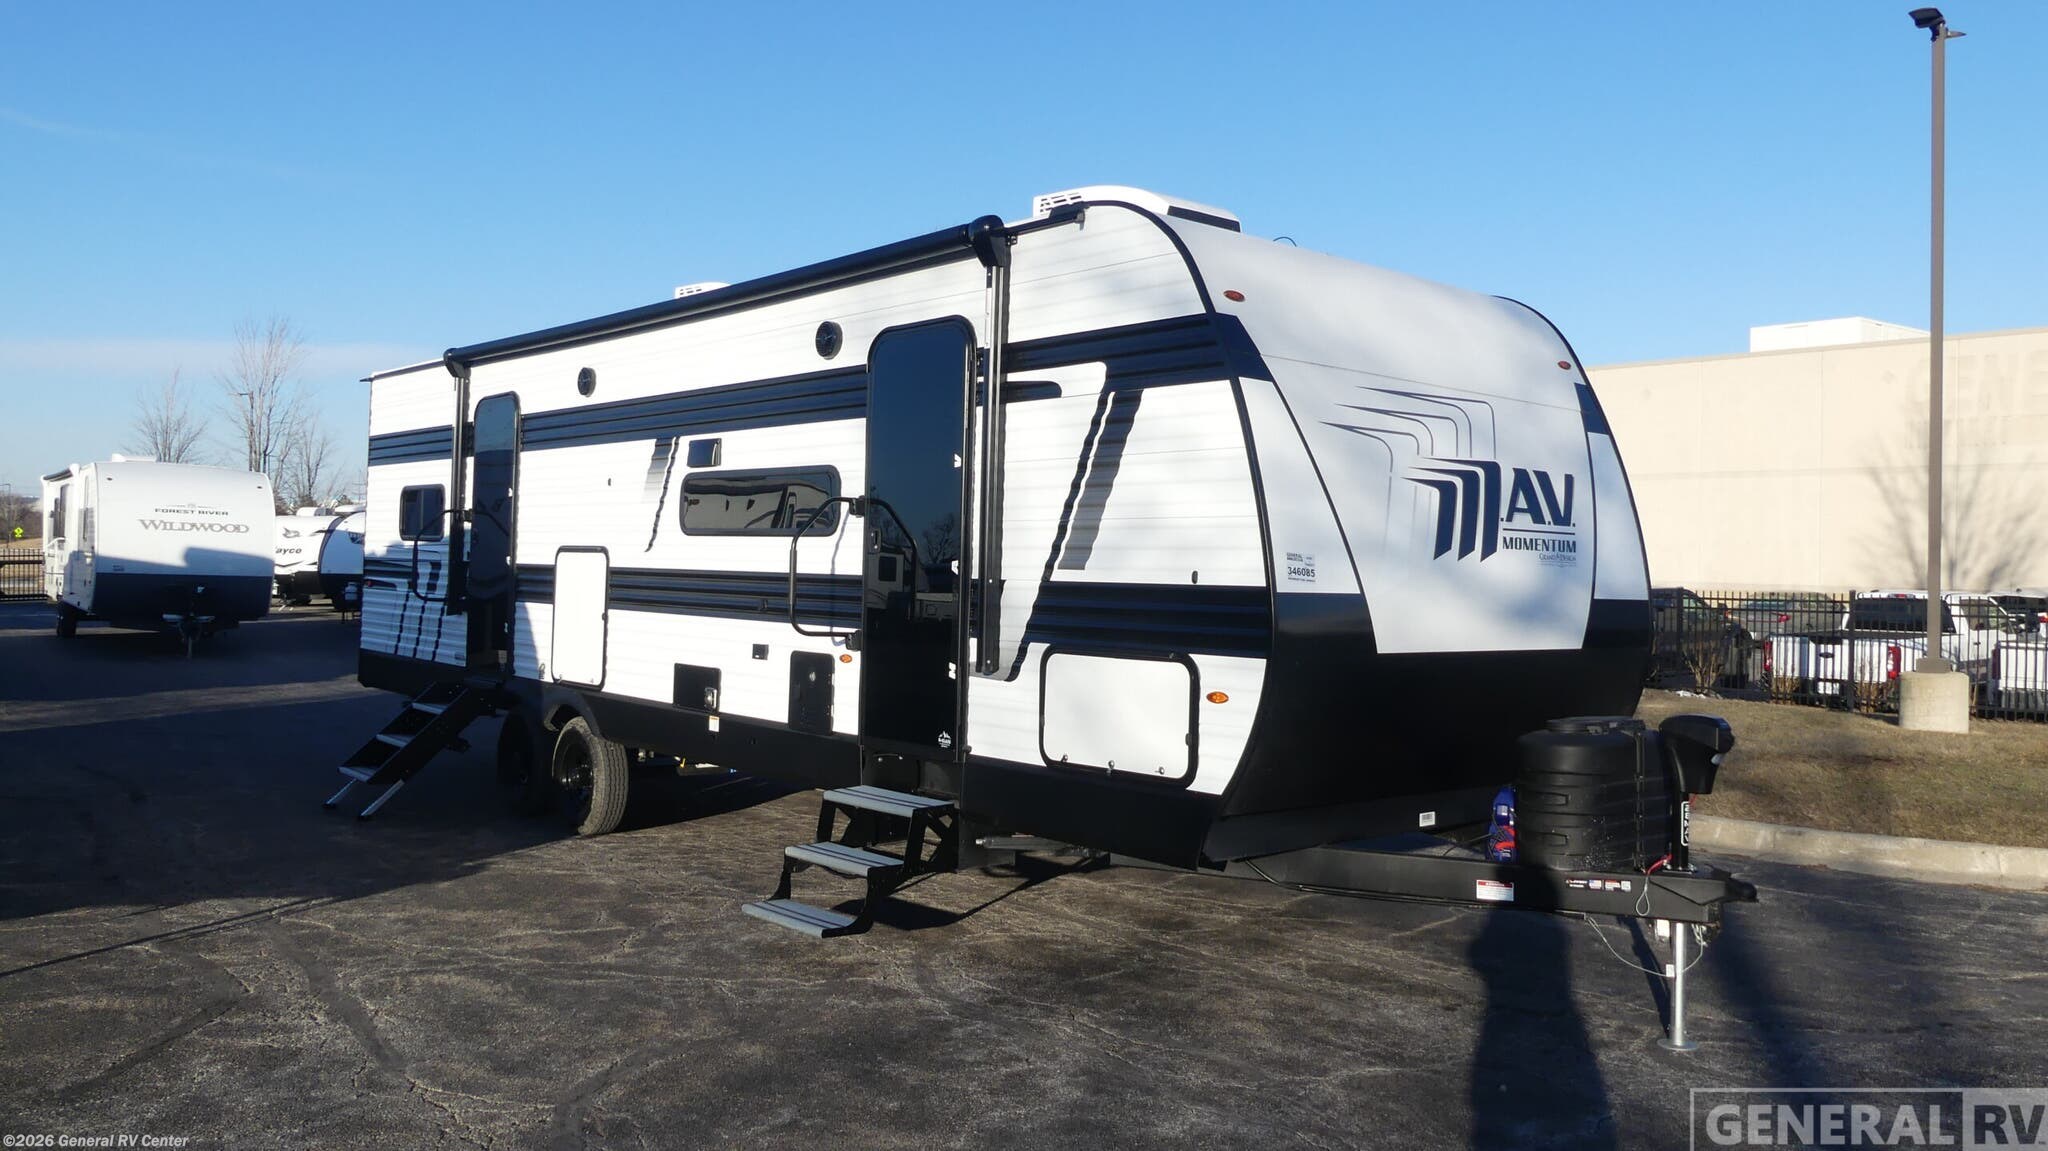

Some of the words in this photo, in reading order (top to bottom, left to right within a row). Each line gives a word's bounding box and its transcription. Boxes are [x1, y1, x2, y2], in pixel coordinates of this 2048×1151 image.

[138, 519, 249, 533] WILDWOOD
[275, 545, 302, 556] ayco
[1502, 536, 1576, 553] MOMENTUM
[1287, 566, 1316, 577] 346085
